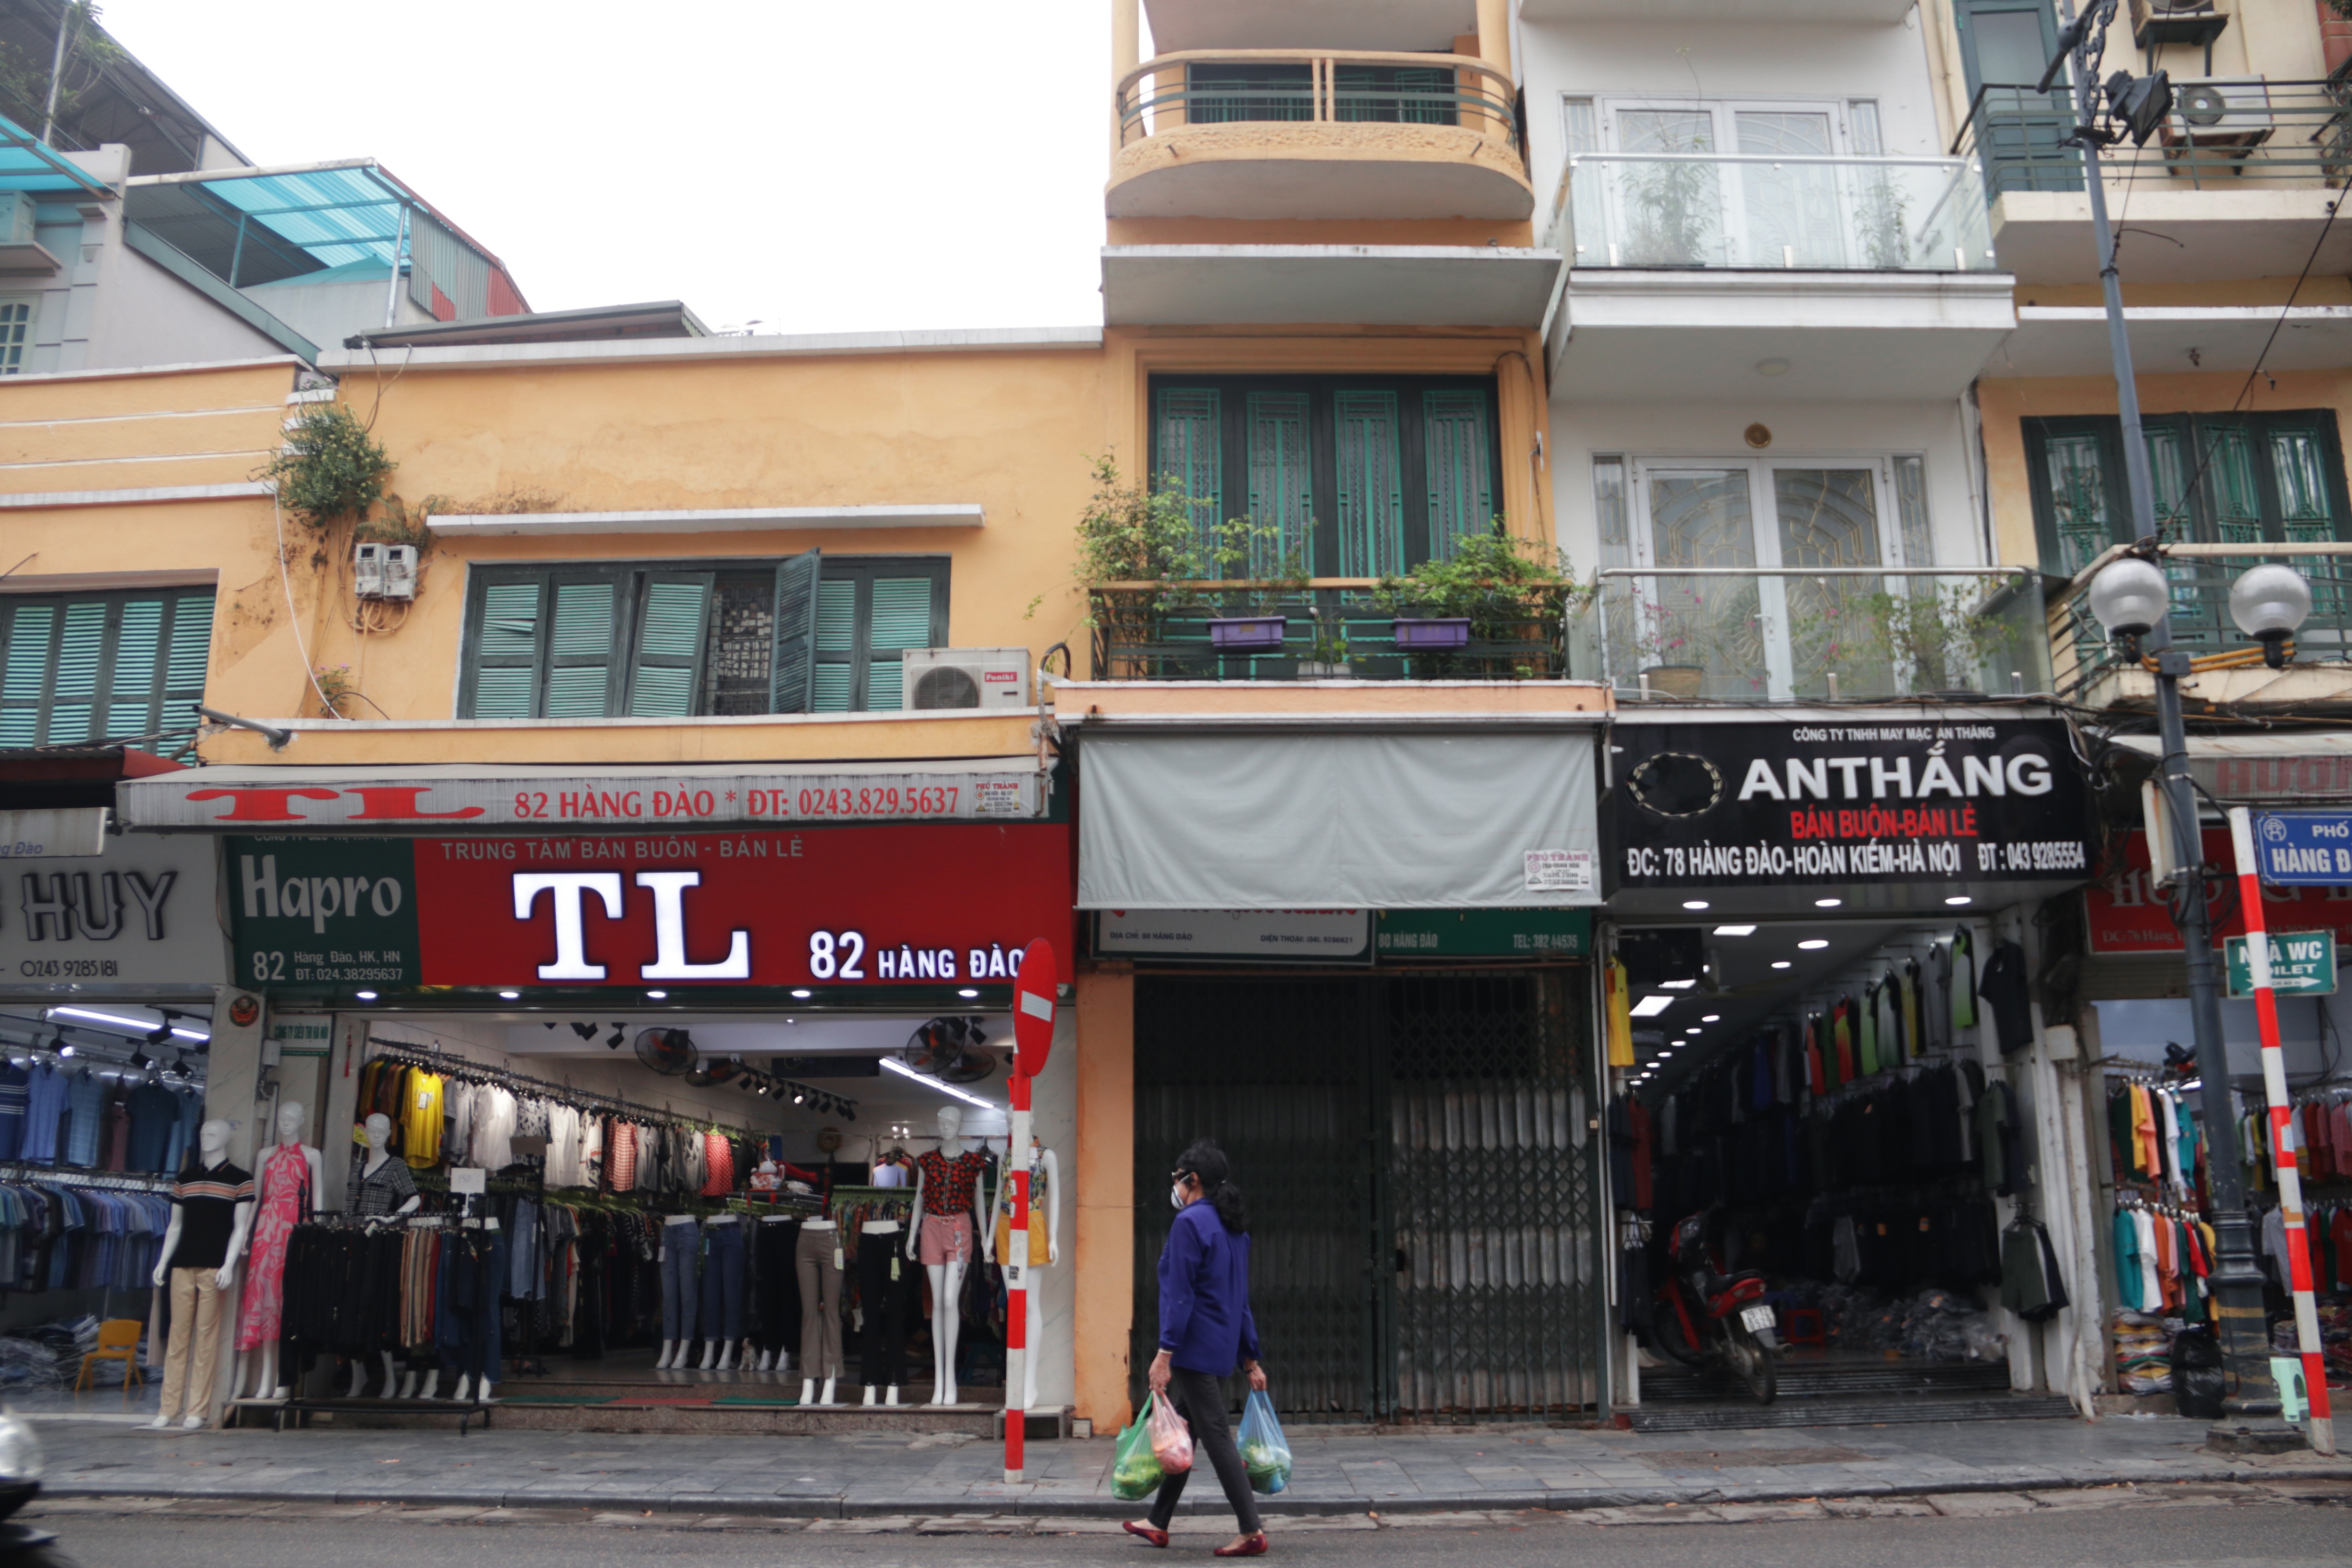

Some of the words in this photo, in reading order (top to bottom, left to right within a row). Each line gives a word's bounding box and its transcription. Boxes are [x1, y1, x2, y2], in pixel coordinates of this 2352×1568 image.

[1793, 726, 1827, 741] CÔNG
[1829, 728, 1843, 740] TY
[1845, 728, 1878, 740] TNHH
[1880, 727, 1904, 740] MAY
[1937, 727, 1954, 740] AN
[1738, 740, 2052, 801] ANTHẮNG
[185, 787, 485, 820] TL
[514, 792, 548, 818] 82
[560, 784, 642, 817] HÀNG
[652, 783, 714, 816] ĐÀO
[747, 788, 789, 815] ĐT:
[798, 787, 959, 815] 0243.829.5637
[1790, 804, 1835, 839] BÁN
[1951, 801, 1978, 836] LẺ
[2312, 820, 2350, 837] PHỐ
[15, 842, 43, 854] Đào
[441, 842, 516, 860] TRUNG
[525, 837, 571, 859] TÂM
[581, 836, 626, 859] BÁN
[635, 835, 697, 859] BUÔN
[720, 835, 768, 858] BÁN
[777, 834, 803, 857] LẺ
[1627, 847, 1660, 876] ĐC:
[1664, 847, 1685, 876] 78
[1689, 839, 1742, 876] HÀNG
[1928, 840, 1961, 876] NỘI
[2006, 842, 2031, 871] 043
[2032, 841, 2085, 870] 9285554
[2271, 842, 2332, 873] HÀNG
[2335, 843, 2352, 873] Đ
[21, 871, 178, 941] HUY
[240, 854, 402, 933] Hapro
[512, 870, 750, 980] TL
[1152, 931, 1174, 940] HÀNG
[1378, 933, 1391, 948] 80
[1393, 930, 1417, 947] HÀNG
[1419, 930, 1438, 948] ĐÀO
[809, 930, 865, 979] 82
[878, 944, 955, 979] HÀNG
[1513, 934, 1530, 948] TEL:
[1533, 934, 1549, 948] 382
[1551, 934, 1578, 949] 44535
[2239, 940, 2282, 964] NÀ
[2287, 941, 2323, 961] WC
[20, 960, 60, 977] 0243
[253, 951, 286, 981] 82
[294, 951, 324, 965] Hàng
[330, 950, 356, 964] Đào,
[359, 950, 380, 964] HK,
[383, 950, 401, 963] HN
[295, 968, 314, 980] ĐT:
[317, 968, 403, 980] 024.38295637
[2245, 963, 2317, 976] ILET
